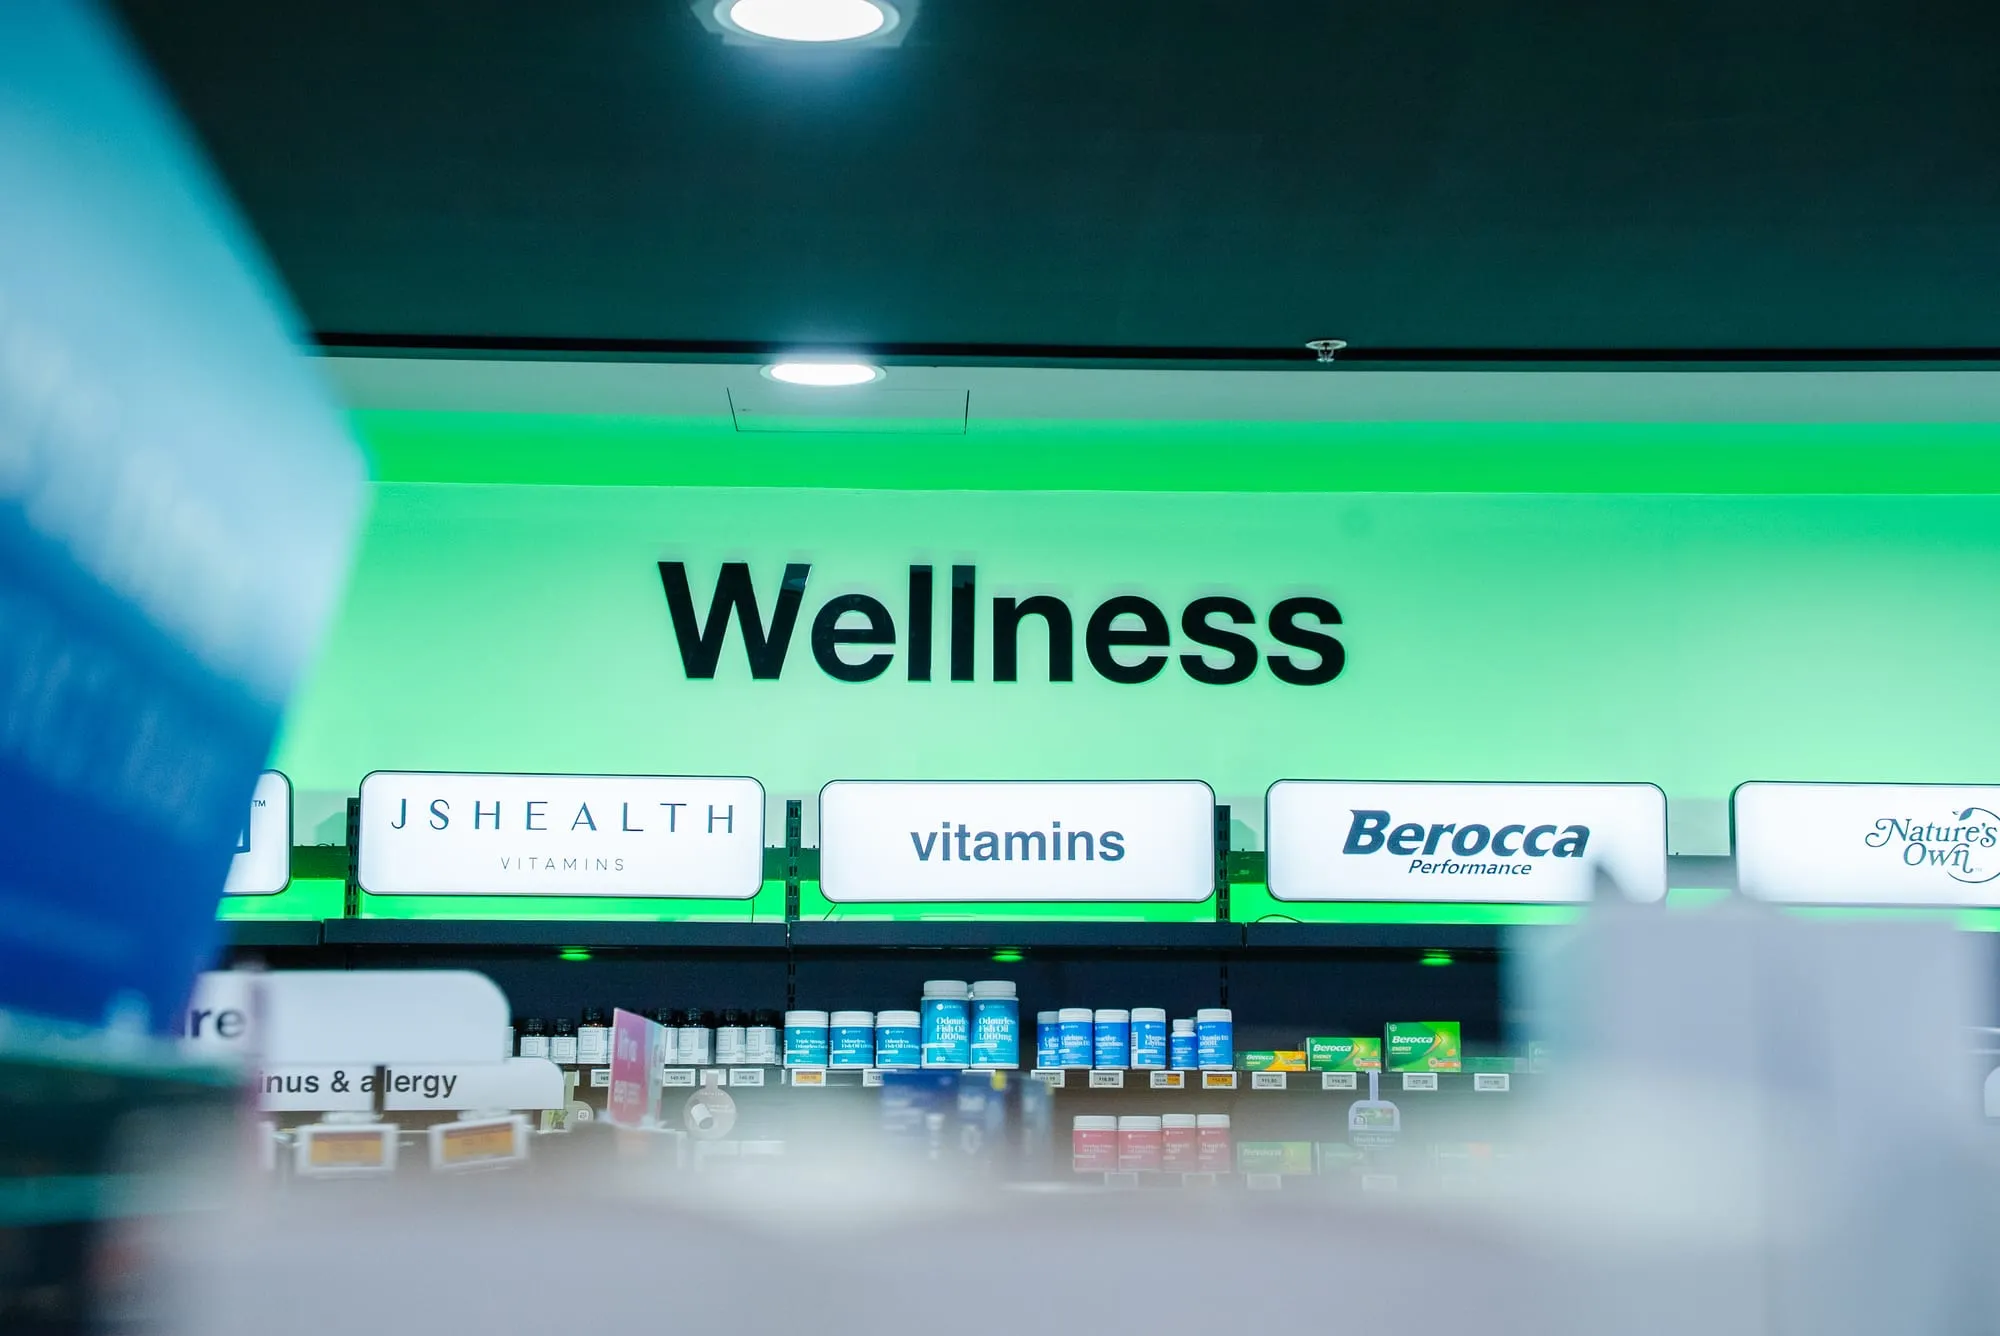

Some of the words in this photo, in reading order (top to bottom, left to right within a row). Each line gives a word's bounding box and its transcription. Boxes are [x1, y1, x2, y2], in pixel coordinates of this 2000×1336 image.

[658, 561, 1346, 686] Wellness
[910, 820, 1126, 862] vitamins
[1342, 808, 1591, 858] Berocca
[1865, 818, 1999, 848] Nature's
[500, 856, 626, 872] VITAMINS
[1408, 858, 1533, 876] Performance
[1903, 842, 1974, 874] Own
[1313, 1044, 1353, 1052] Berocca
[1391, 1035, 1433, 1044] Berocca
[258, 1069, 320, 1093] inus
[330, 1070, 351, 1093] &
[360, 1069, 458, 1099] alergy
